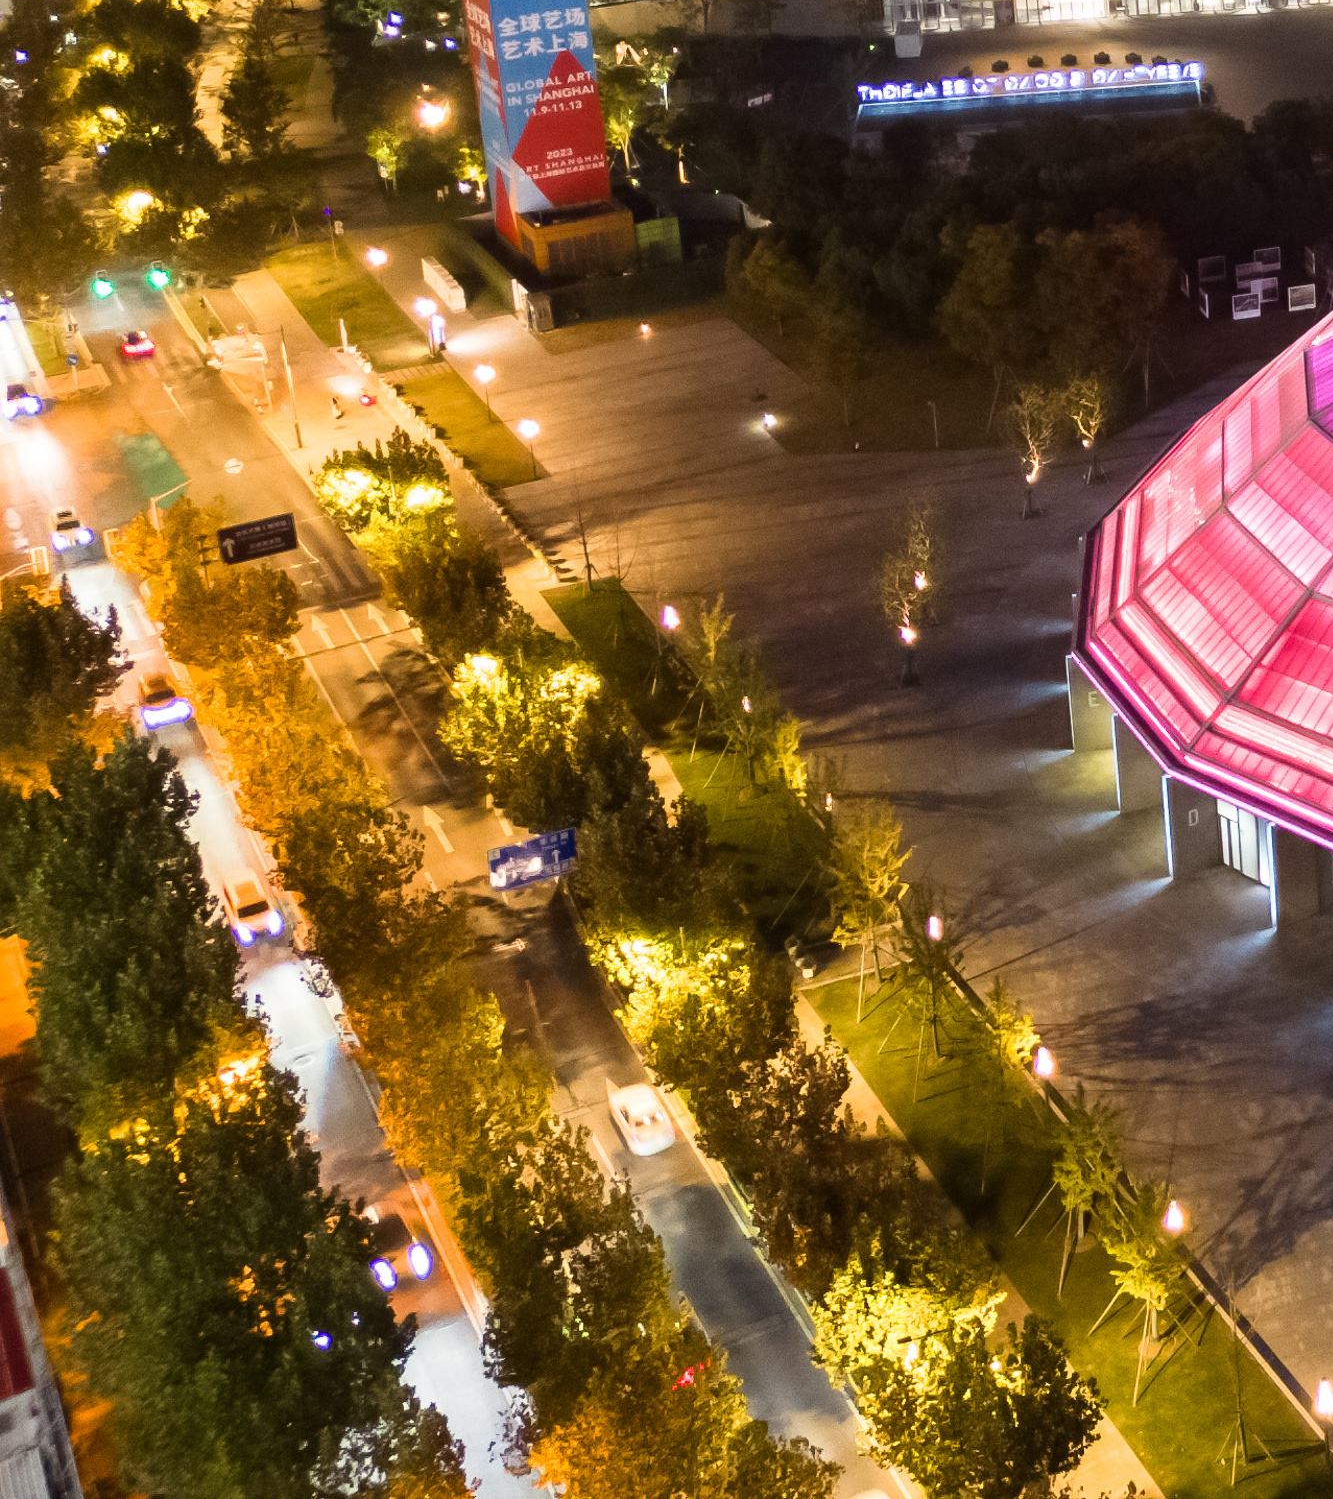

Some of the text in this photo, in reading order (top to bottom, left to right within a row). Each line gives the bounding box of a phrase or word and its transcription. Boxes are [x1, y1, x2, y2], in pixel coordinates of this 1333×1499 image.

[498, 6, 586, 37] 全球艺场
[500, 31, 589, 60] 艺术上海
[505, 71, 592, 93] GLOBAL ART
[507, 84, 594, 106] IN SHANGHAI
[524, 100, 583, 117] 11.9-11.13
[545, 154, 604, 169] SHANGHAI
[546, 147, 573, 159] 2023
[1088, 691, 1100, 707] E
[1188, 809, 1199, 827] D
